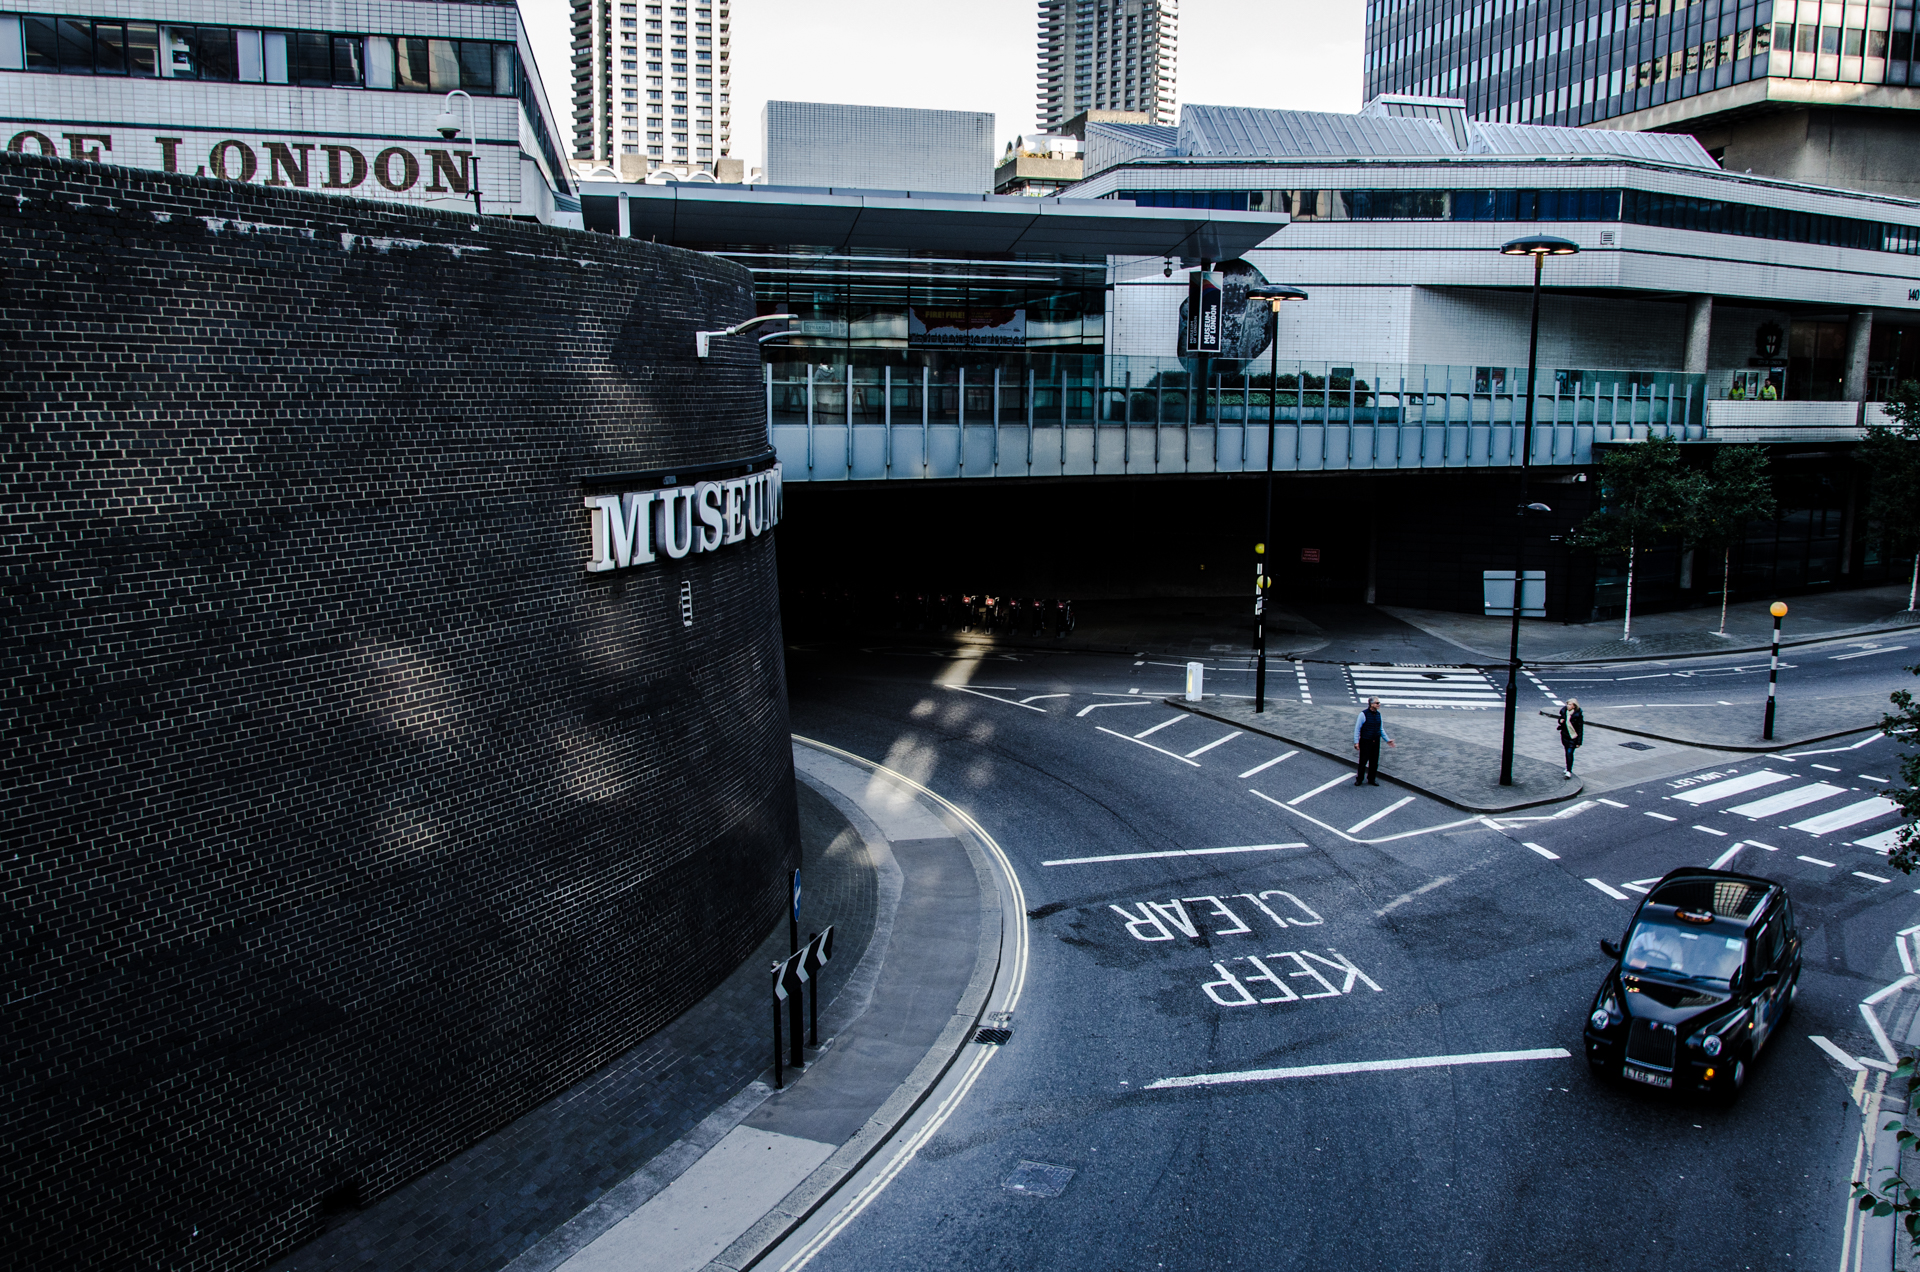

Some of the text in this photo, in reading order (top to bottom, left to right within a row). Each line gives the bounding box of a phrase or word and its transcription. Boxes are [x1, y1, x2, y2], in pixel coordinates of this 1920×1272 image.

[155, 136, 473, 193] LONDON
[925, 311, 945, 319] FIRE!
[946, 311, 965, 319] FIRE!
[1210, 334, 1216, 344] OF
[585, 461, 783, 572] MUSEUM
[1108, 890, 1324, 942] CLEAR
[1201, 948, 1383, 1007] KEEP
